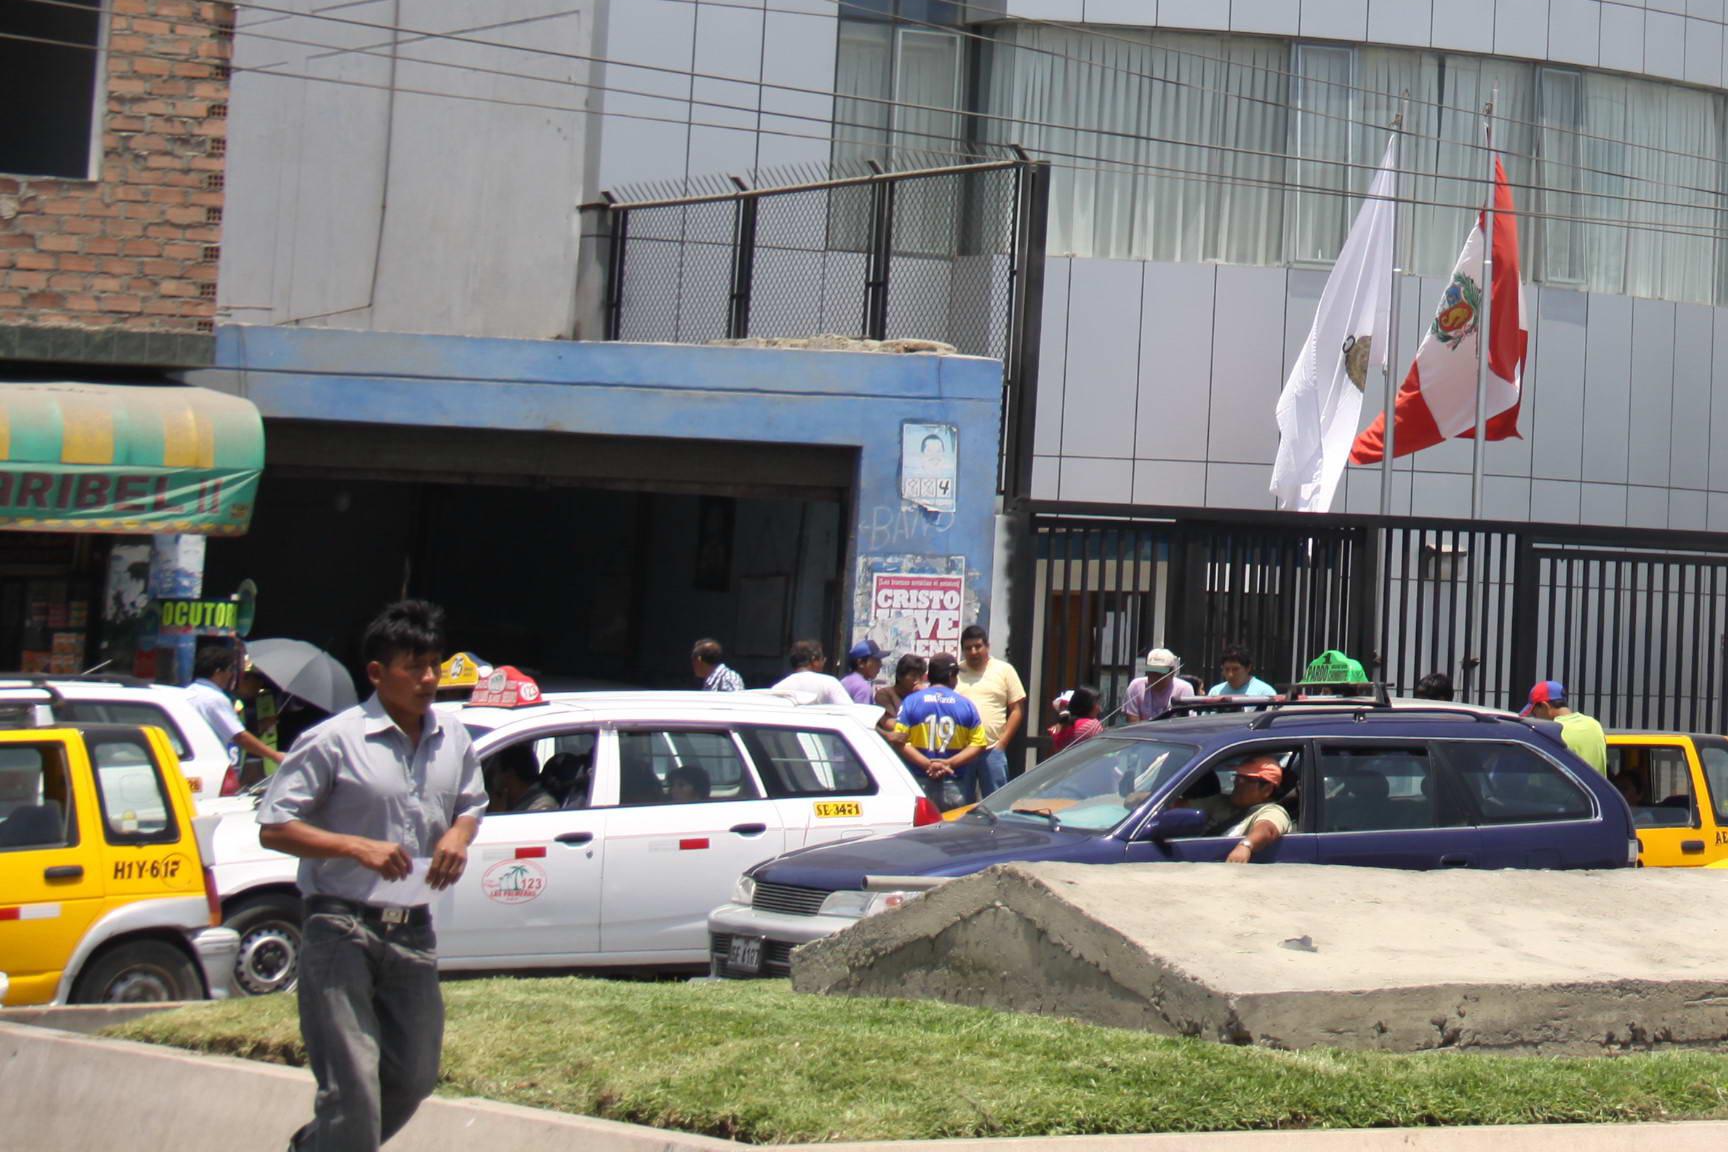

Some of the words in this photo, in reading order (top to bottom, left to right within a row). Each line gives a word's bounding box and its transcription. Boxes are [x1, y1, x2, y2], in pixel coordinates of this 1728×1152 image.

[876, 588, 961, 610] CRISTO
[924, 713, 956, 753] 19
[521, 878, 543, 890] 123
